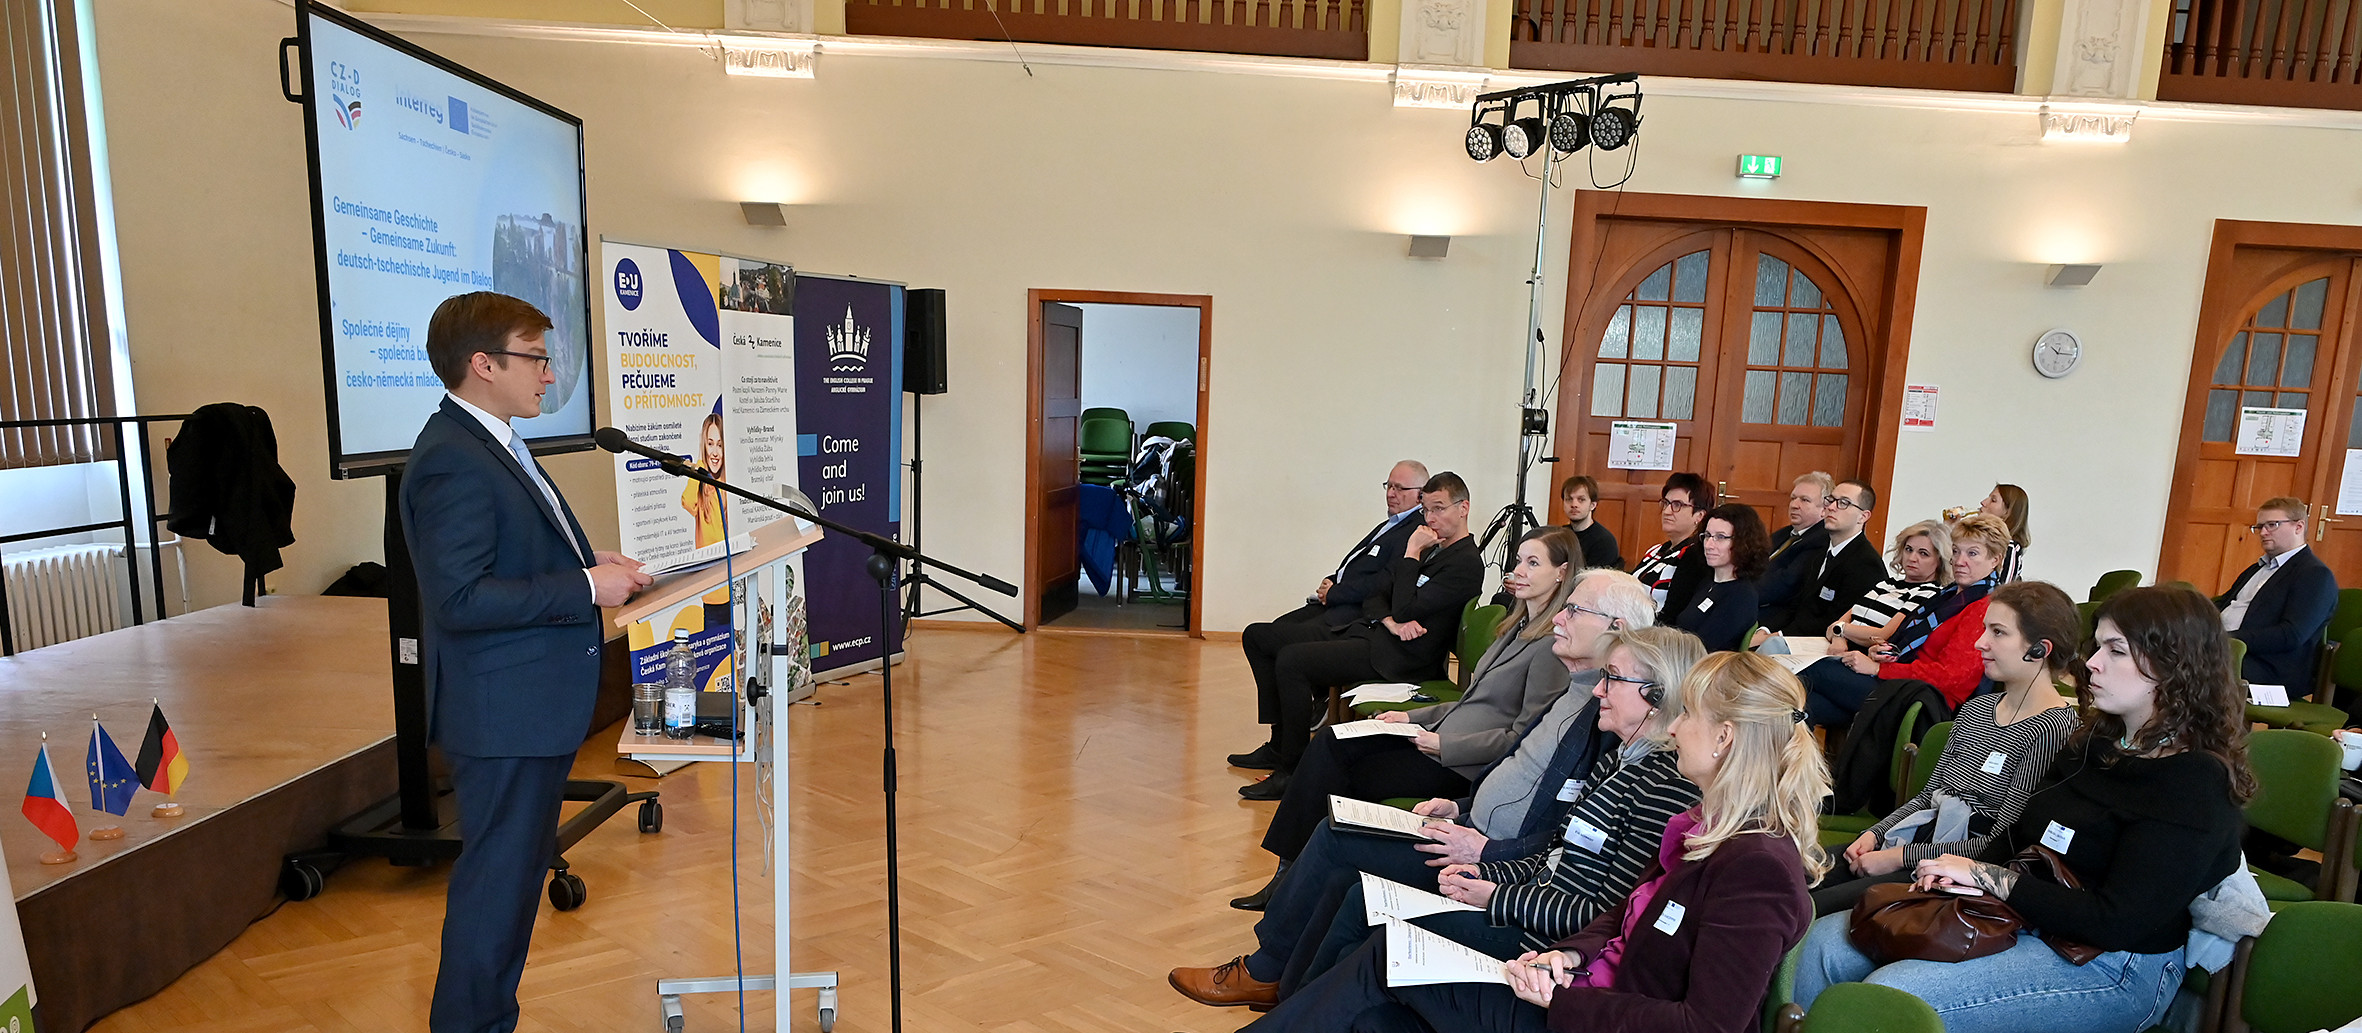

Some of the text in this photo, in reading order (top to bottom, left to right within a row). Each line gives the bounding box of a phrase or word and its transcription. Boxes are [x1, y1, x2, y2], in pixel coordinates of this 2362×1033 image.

[331, 79, 361, 98] DIALOG
[333, 196, 439, 234] Gemeinsame Geschichte
[370, 226, 425, 255] Gemeinsame
[426, 237, 458, 258] Zukunft:
[337, 248, 494, 288] deutsch-tschechische Jugend im Dialog
[342, 319, 410, 343] Společné dějiny
[618, 328, 668, 349] TVOŘÍME
[732, 332, 782, 348] Česká Kamenice
[378, 344, 416, 364] společná
[620, 353, 698, 373] BUDOUCNOST,
[346, 370, 414, 388] česko-německá
[622, 370, 676, 389] PEČUJEME
[624, 391, 706, 409] O PŘÍTOMNOST.
[822, 435, 860, 454] Come
[822, 459, 848, 479] and
[820, 483, 866, 510] join us!
[639, 651, 660, 666] Základní
[706, 631, 731, 646] gymnázium
[703, 643, 727, 656] organizace
[832, 636, 873, 652] www.ecp.cz
[640, 664, 656, 677] Česká
